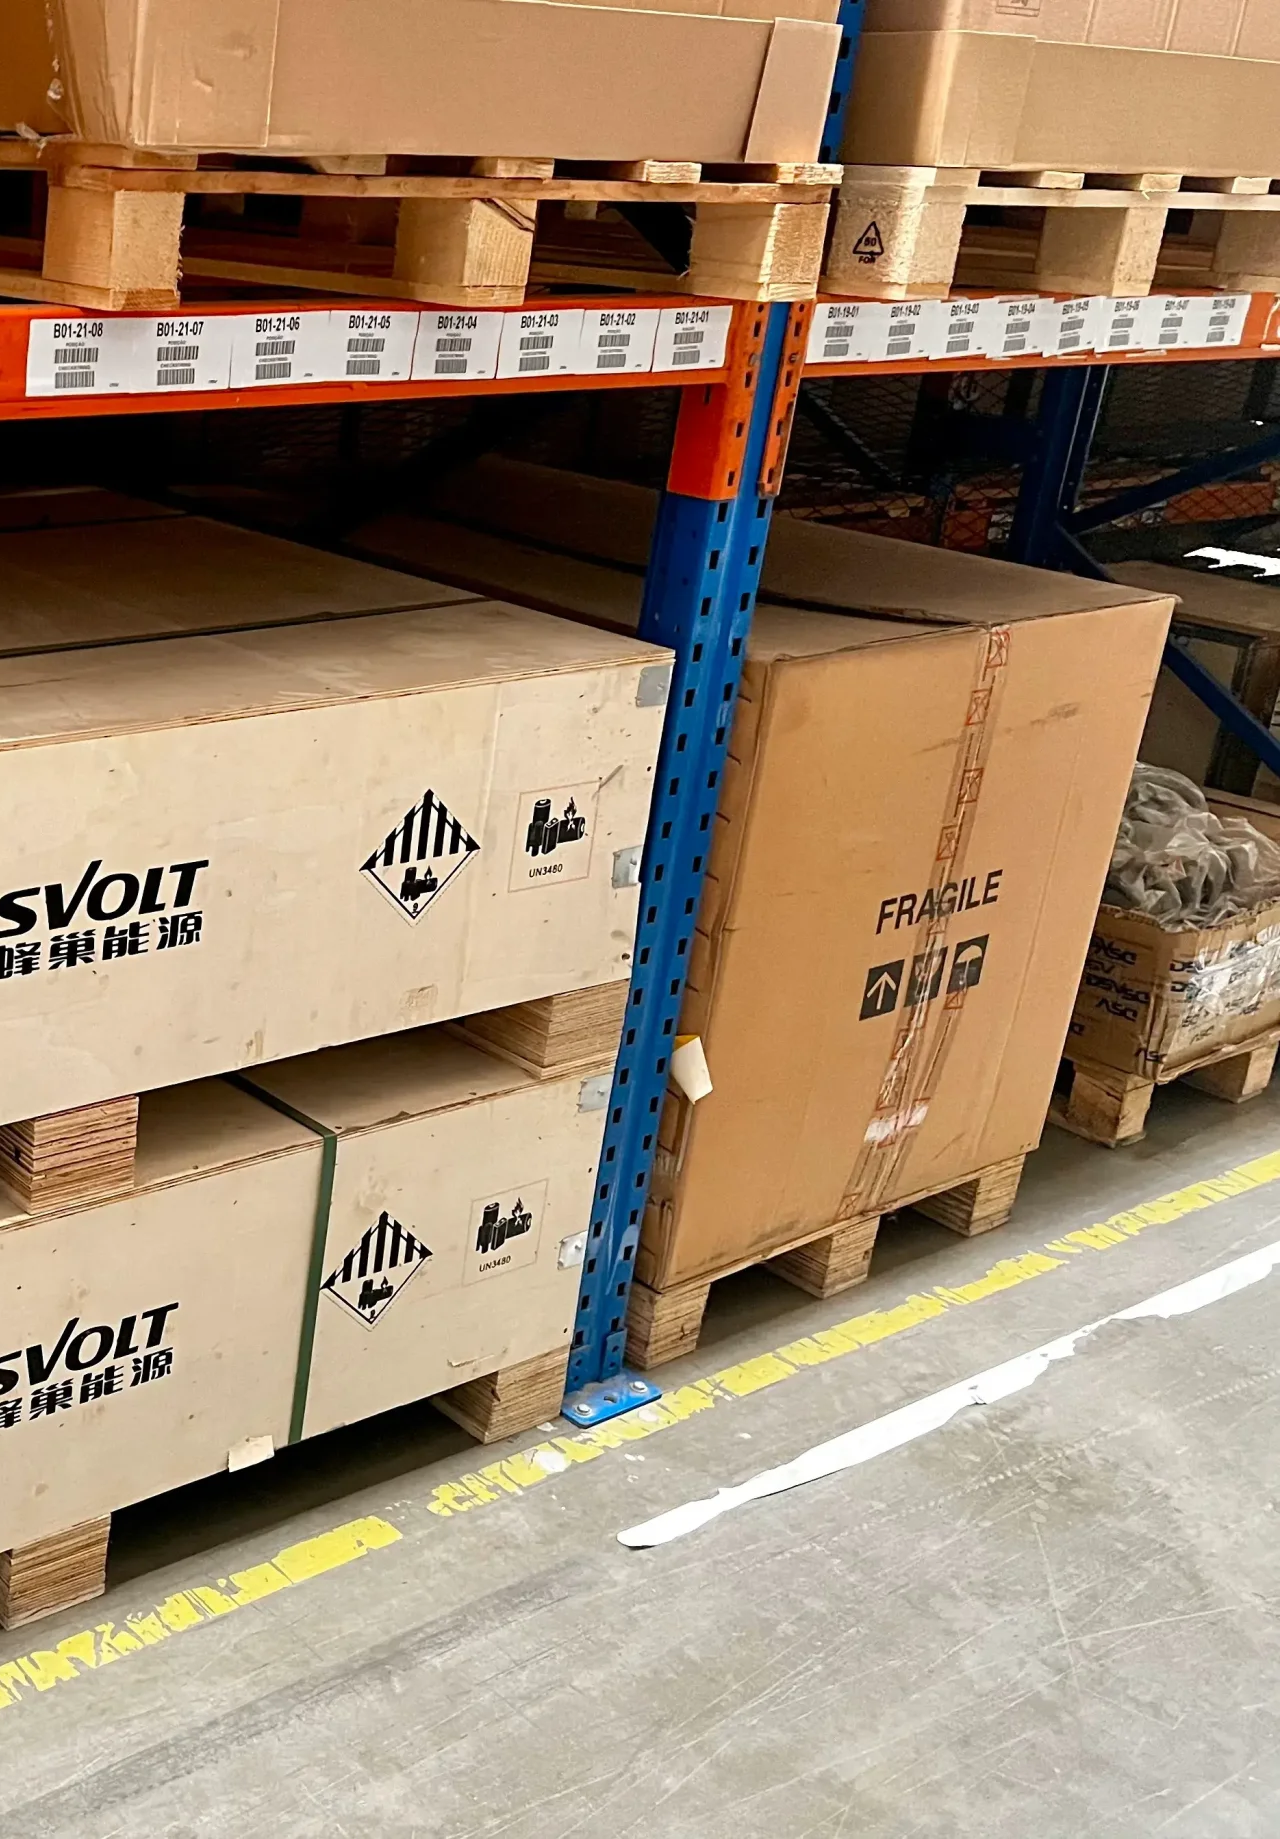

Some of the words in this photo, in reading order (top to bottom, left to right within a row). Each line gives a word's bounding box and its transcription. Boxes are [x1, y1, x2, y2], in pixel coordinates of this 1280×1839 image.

[675, 311, 709, 324] B01-21-01
[828, 306, 860, 318] B01-19-01
[891, 304, 920, 318] B01-19-02
[255, 317, 300, 333] B01-21-06
[349, 315, 391, 329] B01-21-05
[437, 315, 478, 329] B01-21-04
[520, 314, 559, 328] B01-21-03
[600, 313, 636, 326] B01-21-02
[53, 322, 104, 338] B01-21-08
[157, 321, 204, 337] B01-21-07
[529, 863, 563, 878] UN3480
[875, 869, 1003, 935] FRAGILE
[479, 1255, 511, 1273] UN3480
